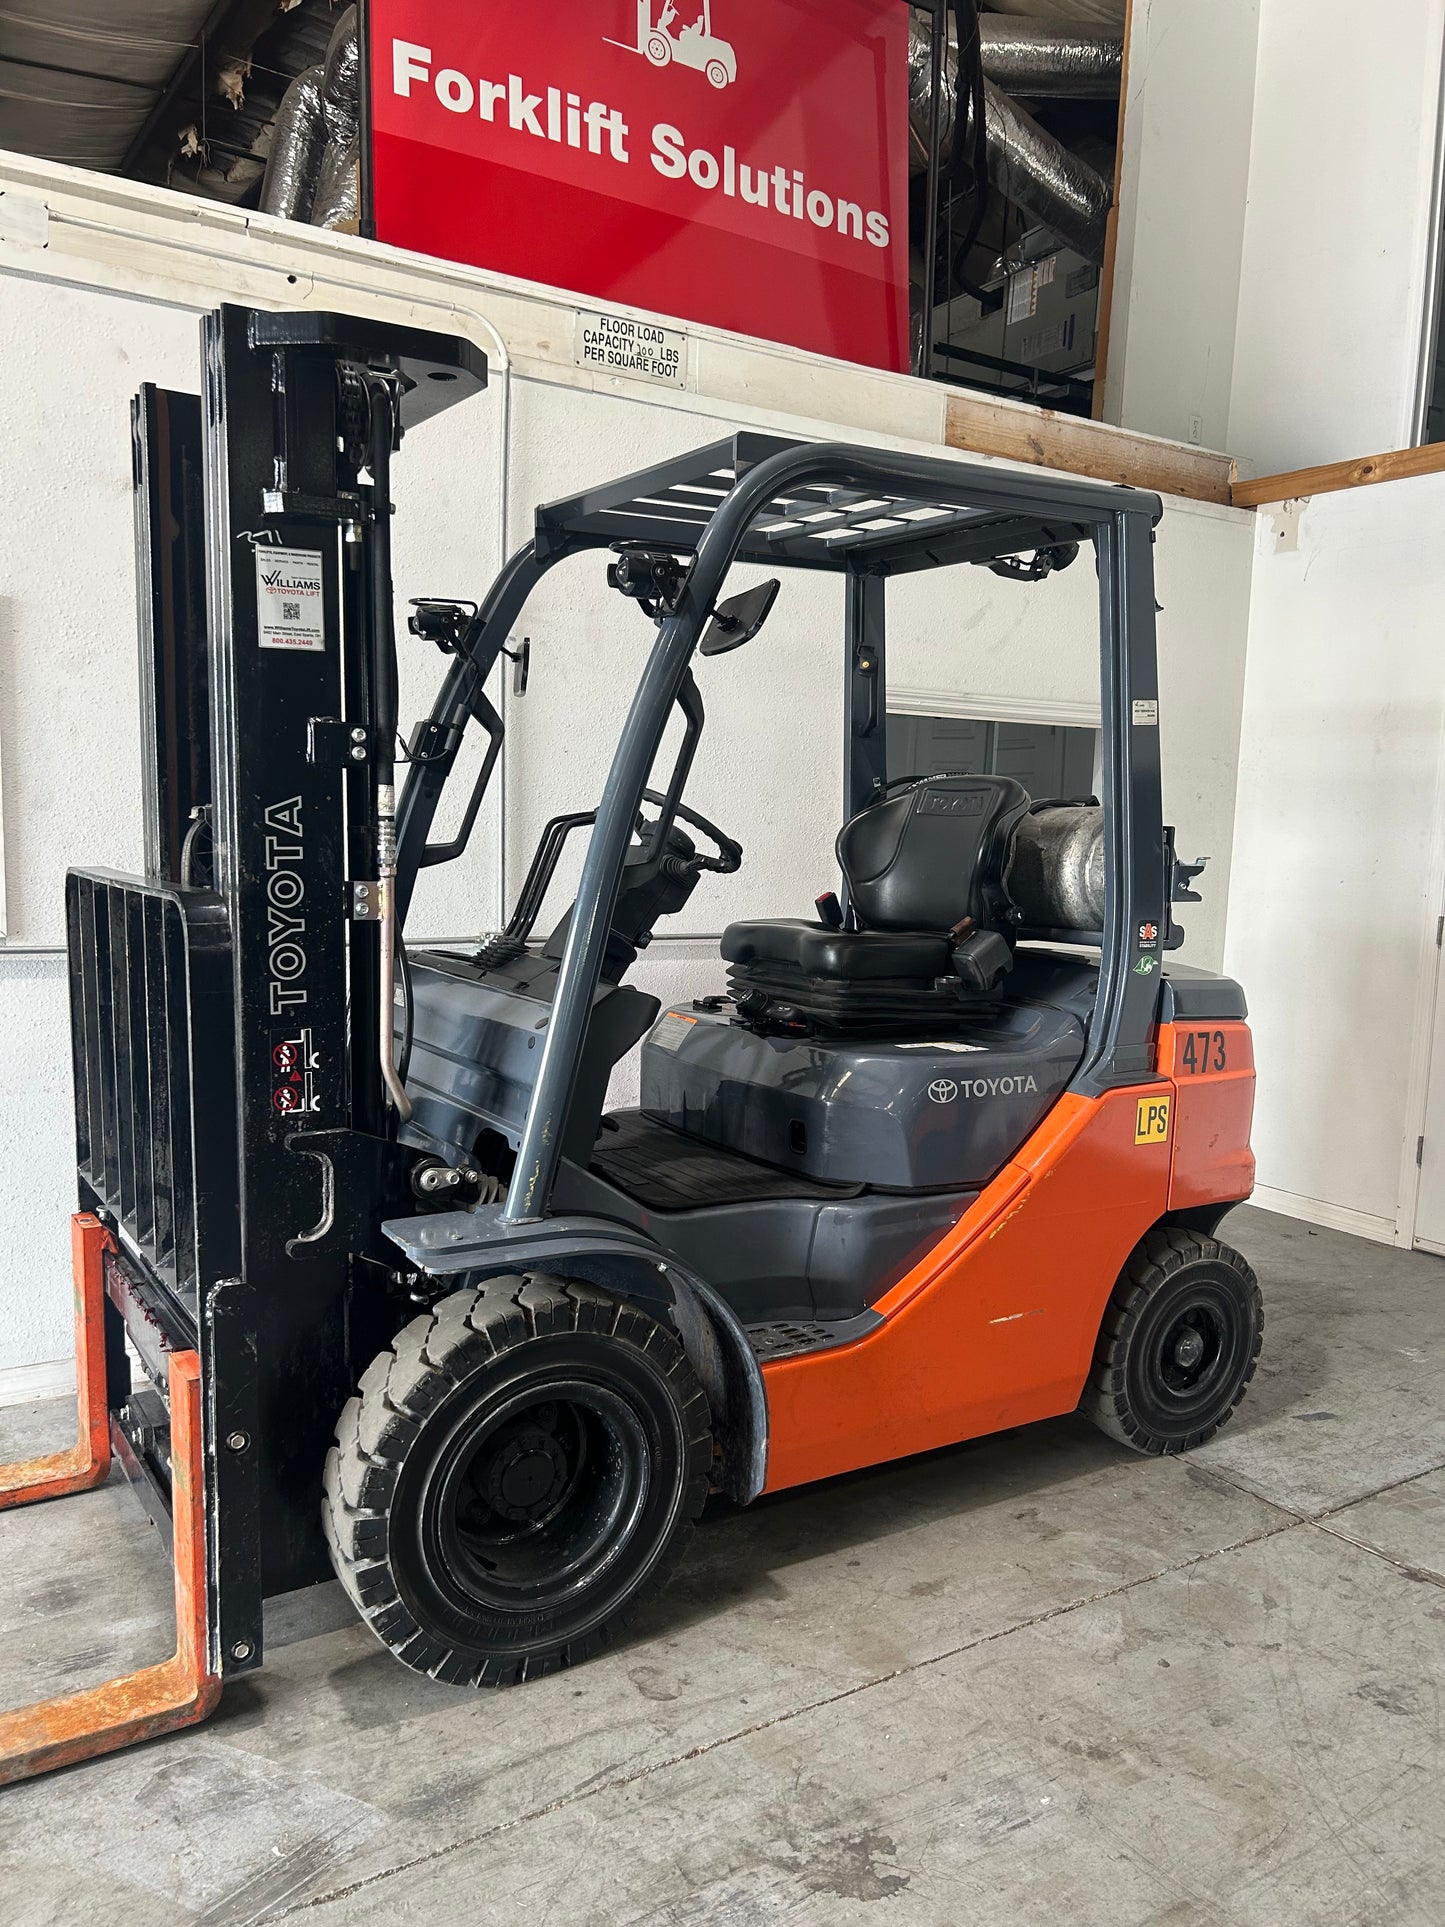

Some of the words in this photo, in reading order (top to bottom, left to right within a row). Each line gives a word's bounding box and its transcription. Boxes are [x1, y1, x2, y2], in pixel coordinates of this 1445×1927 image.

[392, 38, 629, 164] Forklift
[650, 123, 890, 248] Solutions
[583, 329, 635, 353] CAPACITY
[660, 346, 679, 363] LBS
[600, 317, 635, 338] FLOOR
[637, 325, 665, 344] LOAD
[584, 345, 605, 362] PER
[607, 350, 650, 372] SQUARE
[651, 360, 678, 378] FOOT
[261, 570, 321, 591] WILLIAMS
[277, 588, 305, 596] TOYOTA
[265, 795, 308, 1015] TOYOTA
[1138, 923, 1158, 940] SAS
[1182, 1030, 1226, 1074] 473
[960, 1075, 1038, 1098] TOYOTA
[1137, 1104, 1167, 1136] LPS
